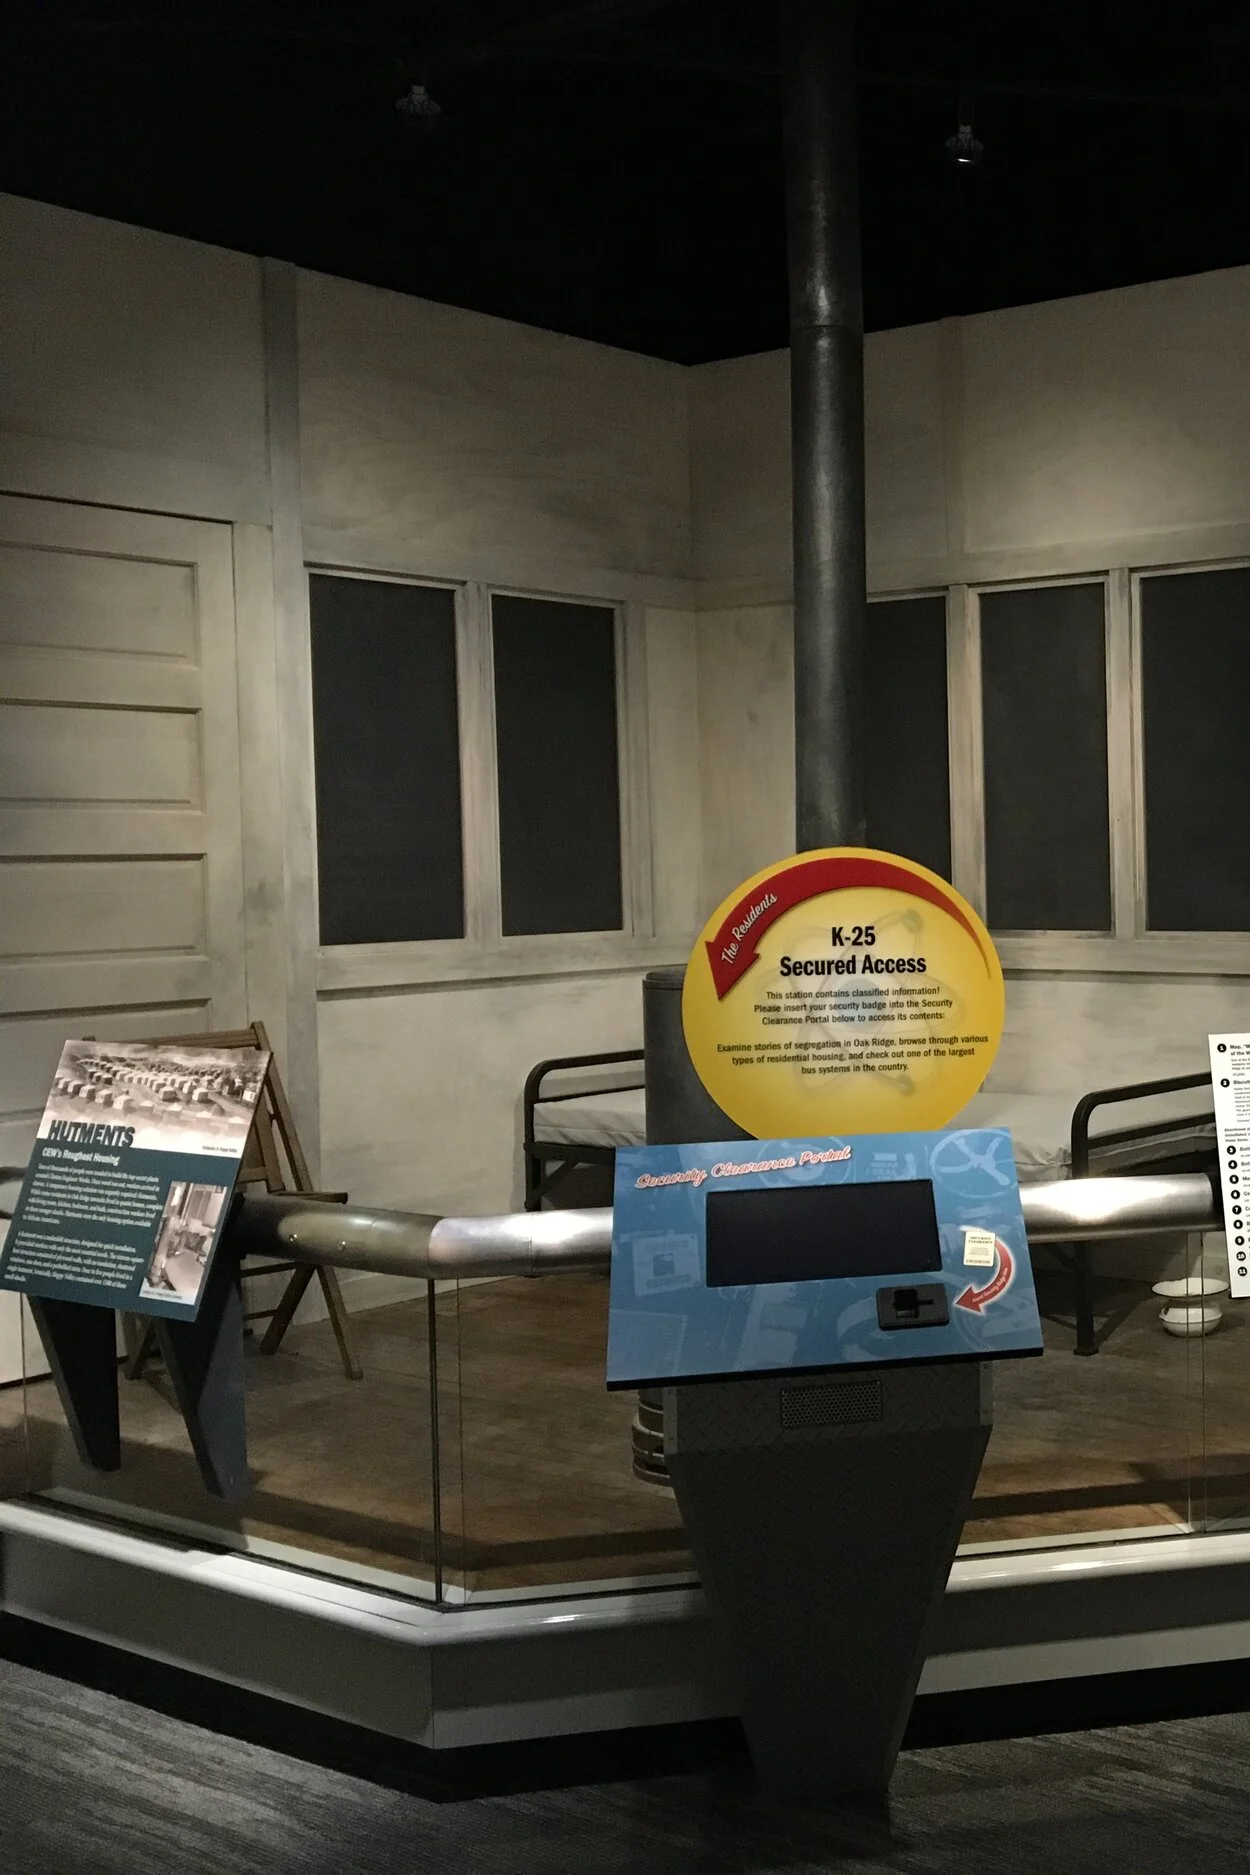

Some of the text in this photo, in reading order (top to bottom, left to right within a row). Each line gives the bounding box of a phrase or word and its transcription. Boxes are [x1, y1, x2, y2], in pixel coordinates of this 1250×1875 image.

[721, 891, 778, 964] The Residents
[831, 926, 876, 946] K-25
[780, 955, 926, 976] Secured Access
[767, 987, 940, 1000] This station contains classified information!
[754, 998, 953, 1014] Please insert your security badge into the Security
[762, 1015, 803, 1025] Clearance
[805, 1014, 829, 1024] Portal
[832, 1014, 855, 1023] below
[897, 1012, 907, 1022] its
[717, 1042, 752, 1053] Examine
[754, 1041, 782, 1051] stories
[794, 1039, 841, 1052] segregation
[854, 1038, 870, 1048] Oak
[899, 1036, 926, 1047] browse
[929, 1035, 959, 1048] through
[961, 1034, 988, 1044] various
[731, 1055, 754, 1067] types
[767, 1053, 810, 1063] residential
[848, 1051, 863, 1061] and
[866, 1050, 889, 1060] check
[891, 1050, 904, 1059] out
[933, 1048, 946, 1058] the
[948, 1047, 975, 1060] largest
[801, 1065, 816, 1075] bus
[818, 1064, 851, 1076] systems
[862, 1063, 876, 1073] the
[878, 1062, 910, 1075] country.
[47, 1120, 135, 1147] HUTMENTS
[634, 1146, 852, 1188] Security Clearance Portal
